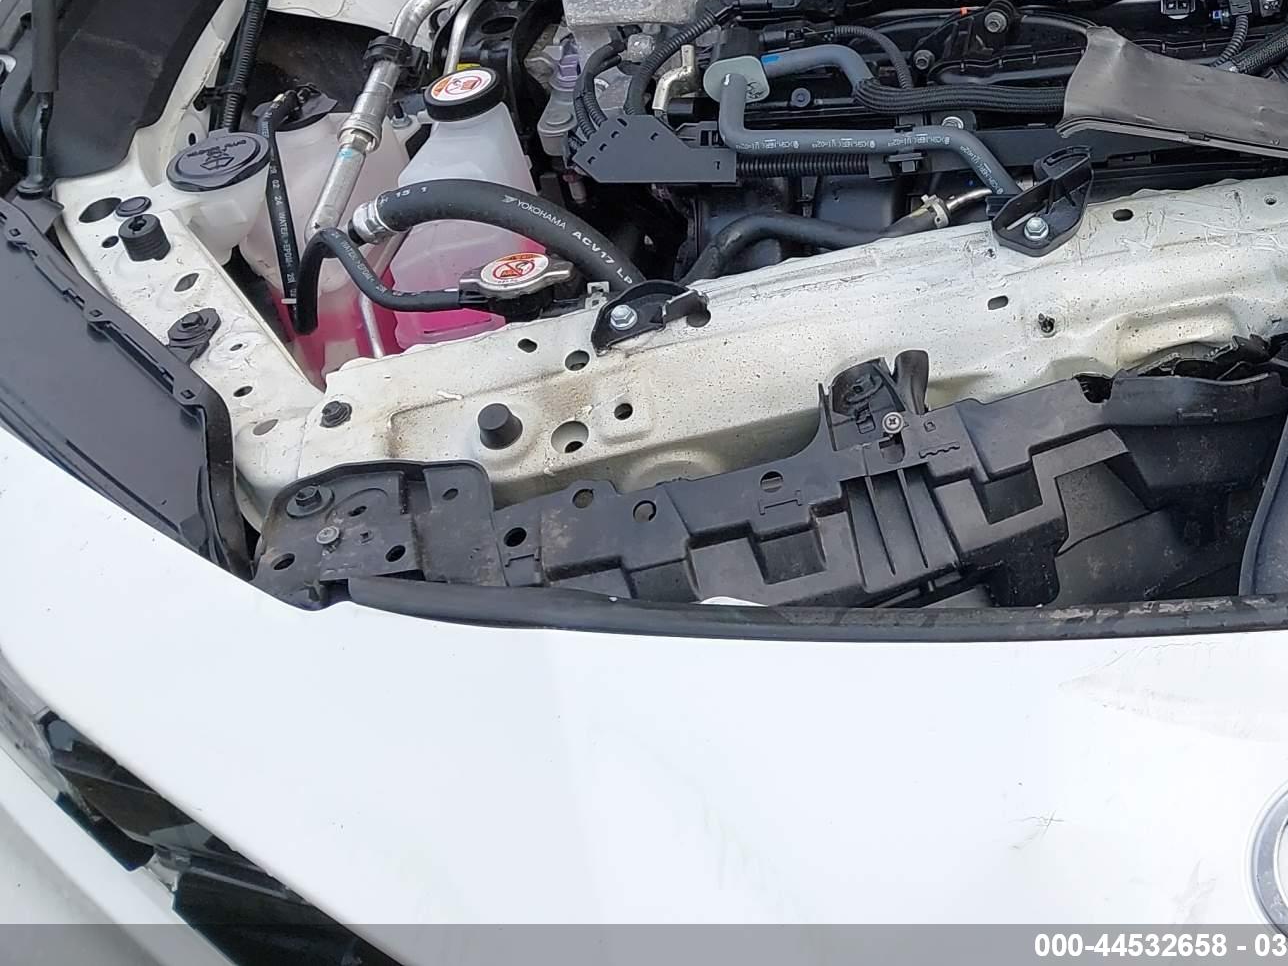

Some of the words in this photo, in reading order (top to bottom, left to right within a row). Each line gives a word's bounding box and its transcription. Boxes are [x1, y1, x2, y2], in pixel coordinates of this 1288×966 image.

[517, 200, 567, 230] YOKOHAMA
[572, 231, 616, 264] ACV17
[616, 267, 633, 285] LP
